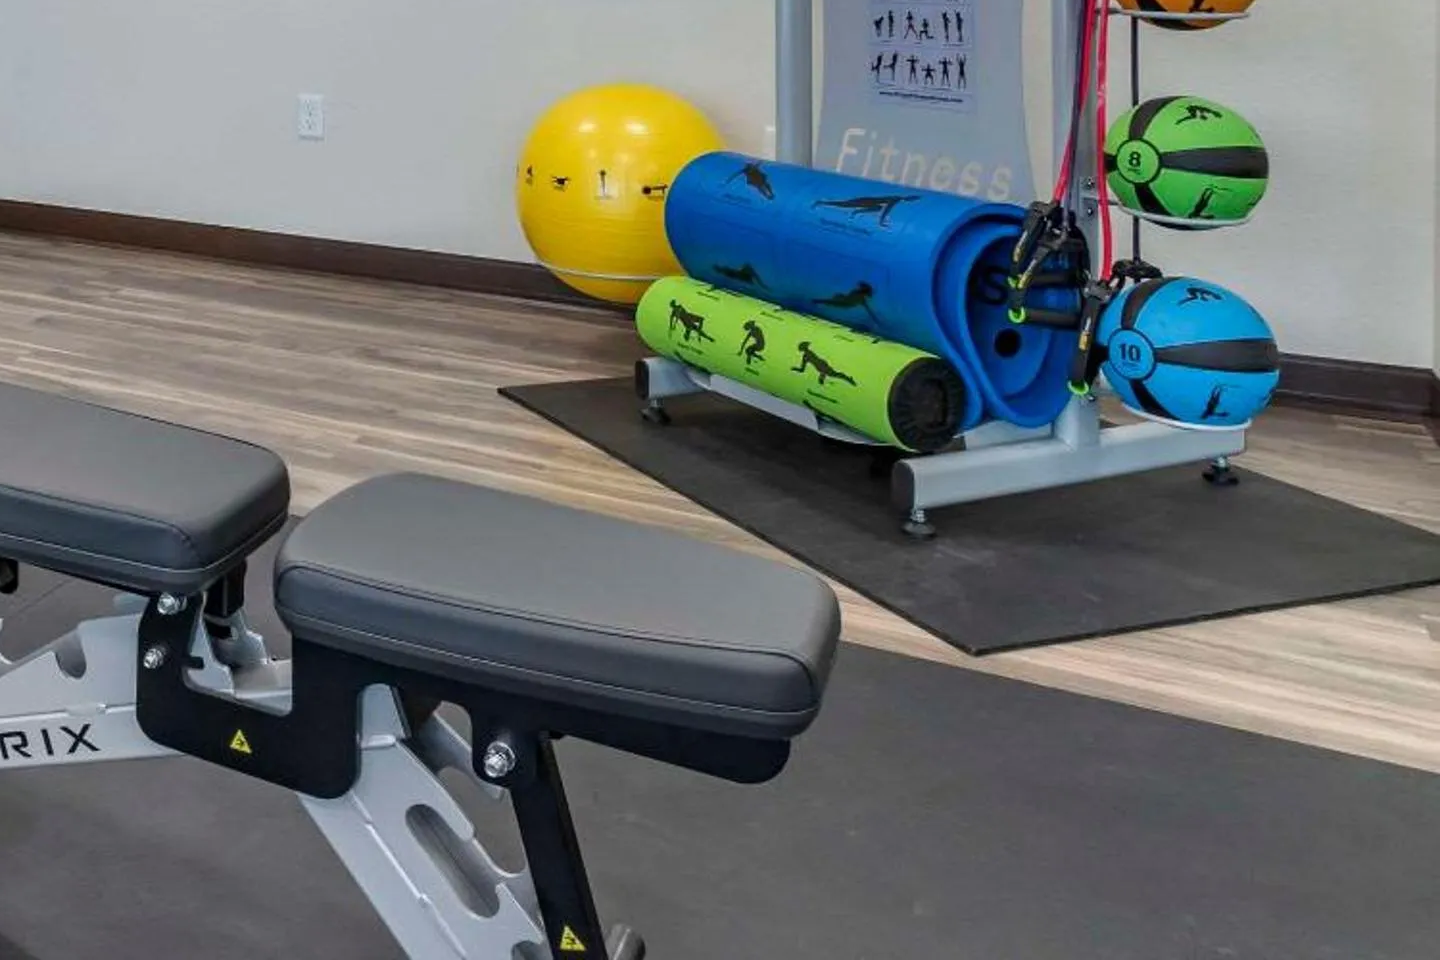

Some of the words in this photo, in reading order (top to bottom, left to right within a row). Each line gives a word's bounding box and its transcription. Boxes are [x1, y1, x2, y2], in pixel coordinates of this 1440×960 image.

[836, 127, 1013, 202] Fitness
[1128, 150, 1141, 167] 8
[1117, 343, 1141, 361] 10
